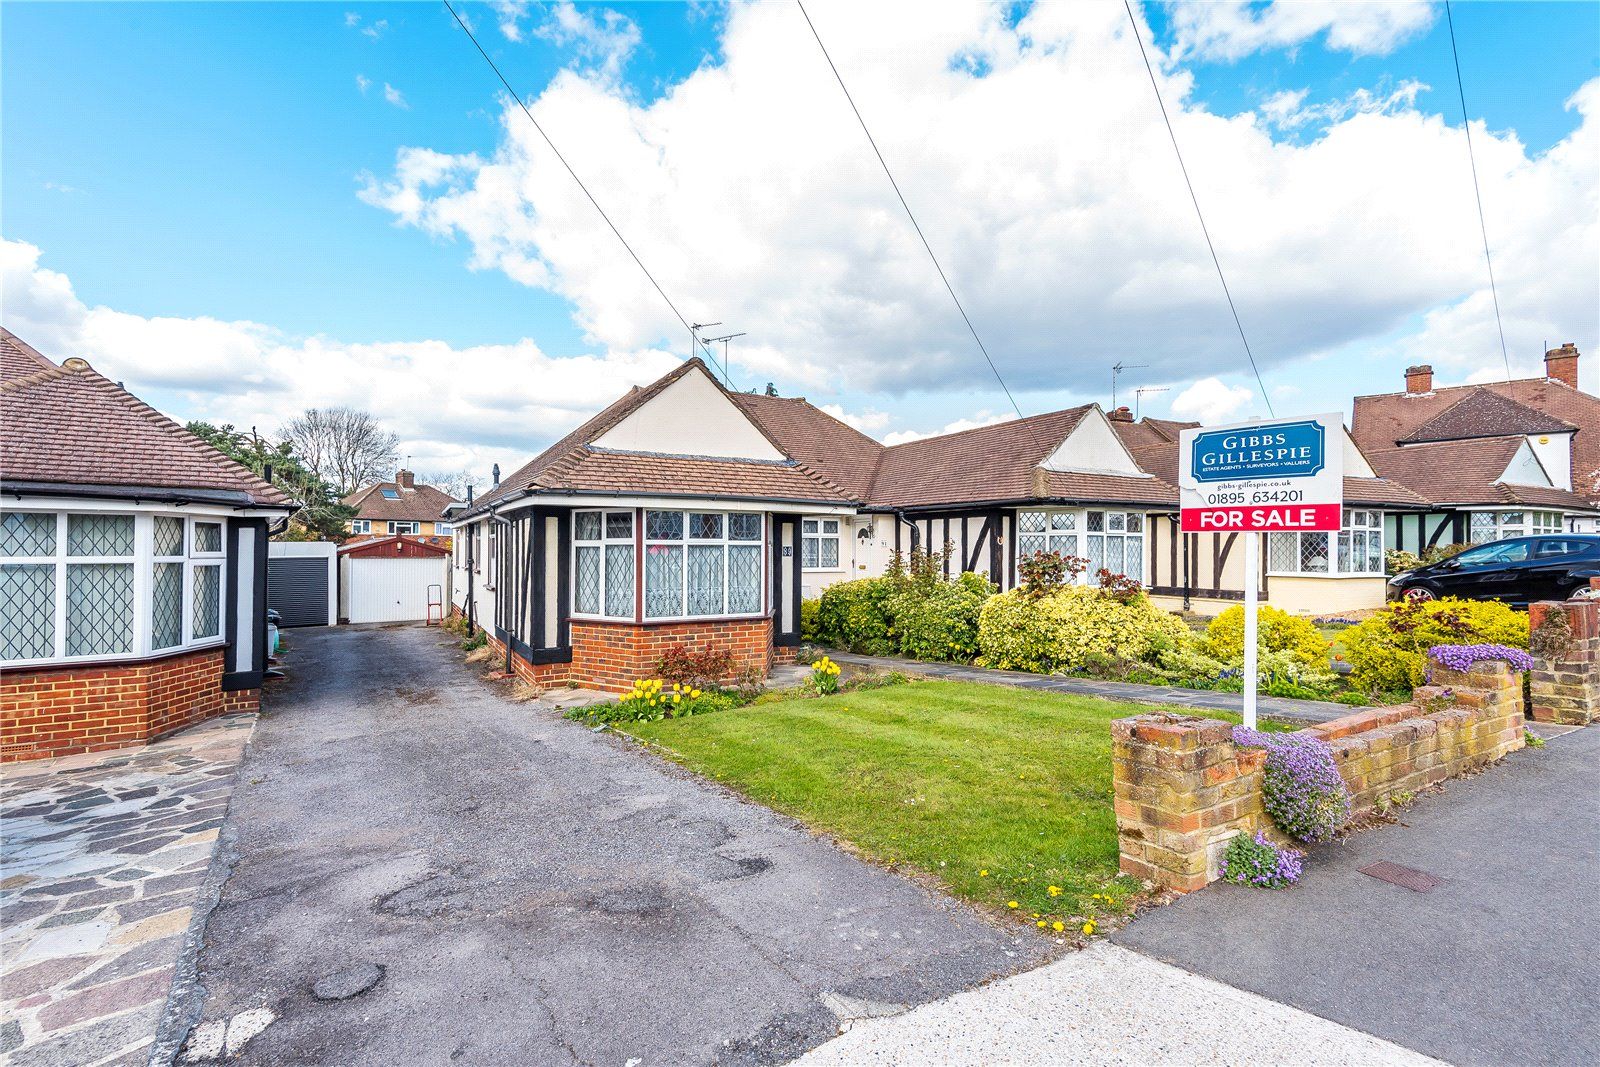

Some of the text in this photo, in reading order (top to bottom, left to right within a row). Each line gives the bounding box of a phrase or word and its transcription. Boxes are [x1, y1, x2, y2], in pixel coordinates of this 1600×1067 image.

[1222, 434, 1286, 449] GIBBS
[1202, 446, 1311, 466] GILLESPIE
[1217, 480, 1291, 491] gibbs-gillespie.co.uk
[1208, 490, 1303, 504] 01895 634201
[1200, 509, 1316, 528] FOR SALE
